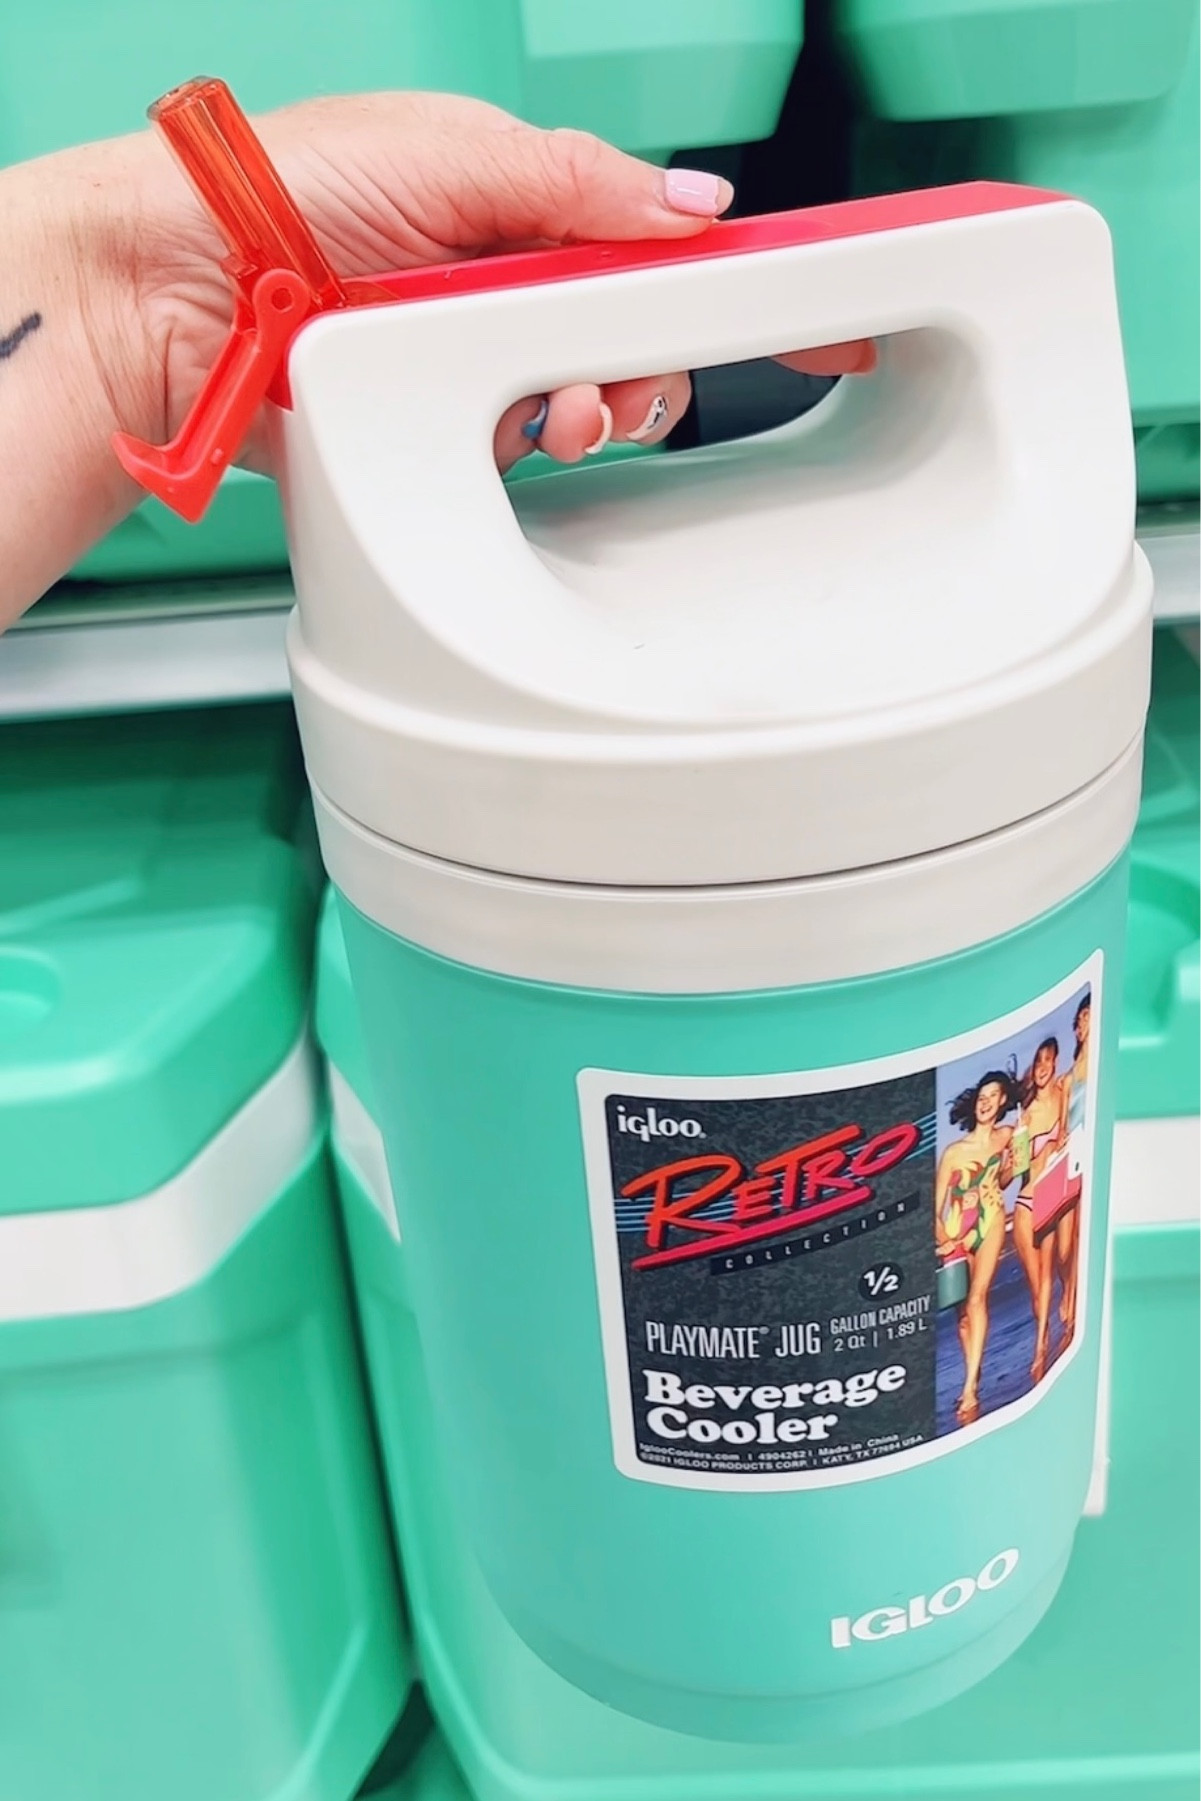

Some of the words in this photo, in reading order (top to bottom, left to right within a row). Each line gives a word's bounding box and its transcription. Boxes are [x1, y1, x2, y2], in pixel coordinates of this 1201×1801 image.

[725, 1202, 905, 1270] COLLECTION
[829, 1309, 876, 1335] GALLON
[878, 1295, 931, 1325] CAPACITY
[775, 1321, 822, 1358] JUG
[834, 1338, 845, 1352] 2
[847, 1334, 867, 1350] Qt
[887, 1320, 916, 1341] 1.89
[918, 1320, 928, 1332] L
[642, 1364, 907, 1411] Beverage
[646, 1405, 839, 1445] Cooler
[818, 1444, 849, 1456] Made
[851, 1442, 863, 1451] in
[866, 1433, 899, 1448] China
[673, 1457, 710, 1469] IGLOO
[711, 1461, 774, 1470] PRODUCTS
[855, 1450, 870, 1460] TX
[902, 1434, 924, 1448] USA
[830, 1546, 1020, 1649] IGLOO
